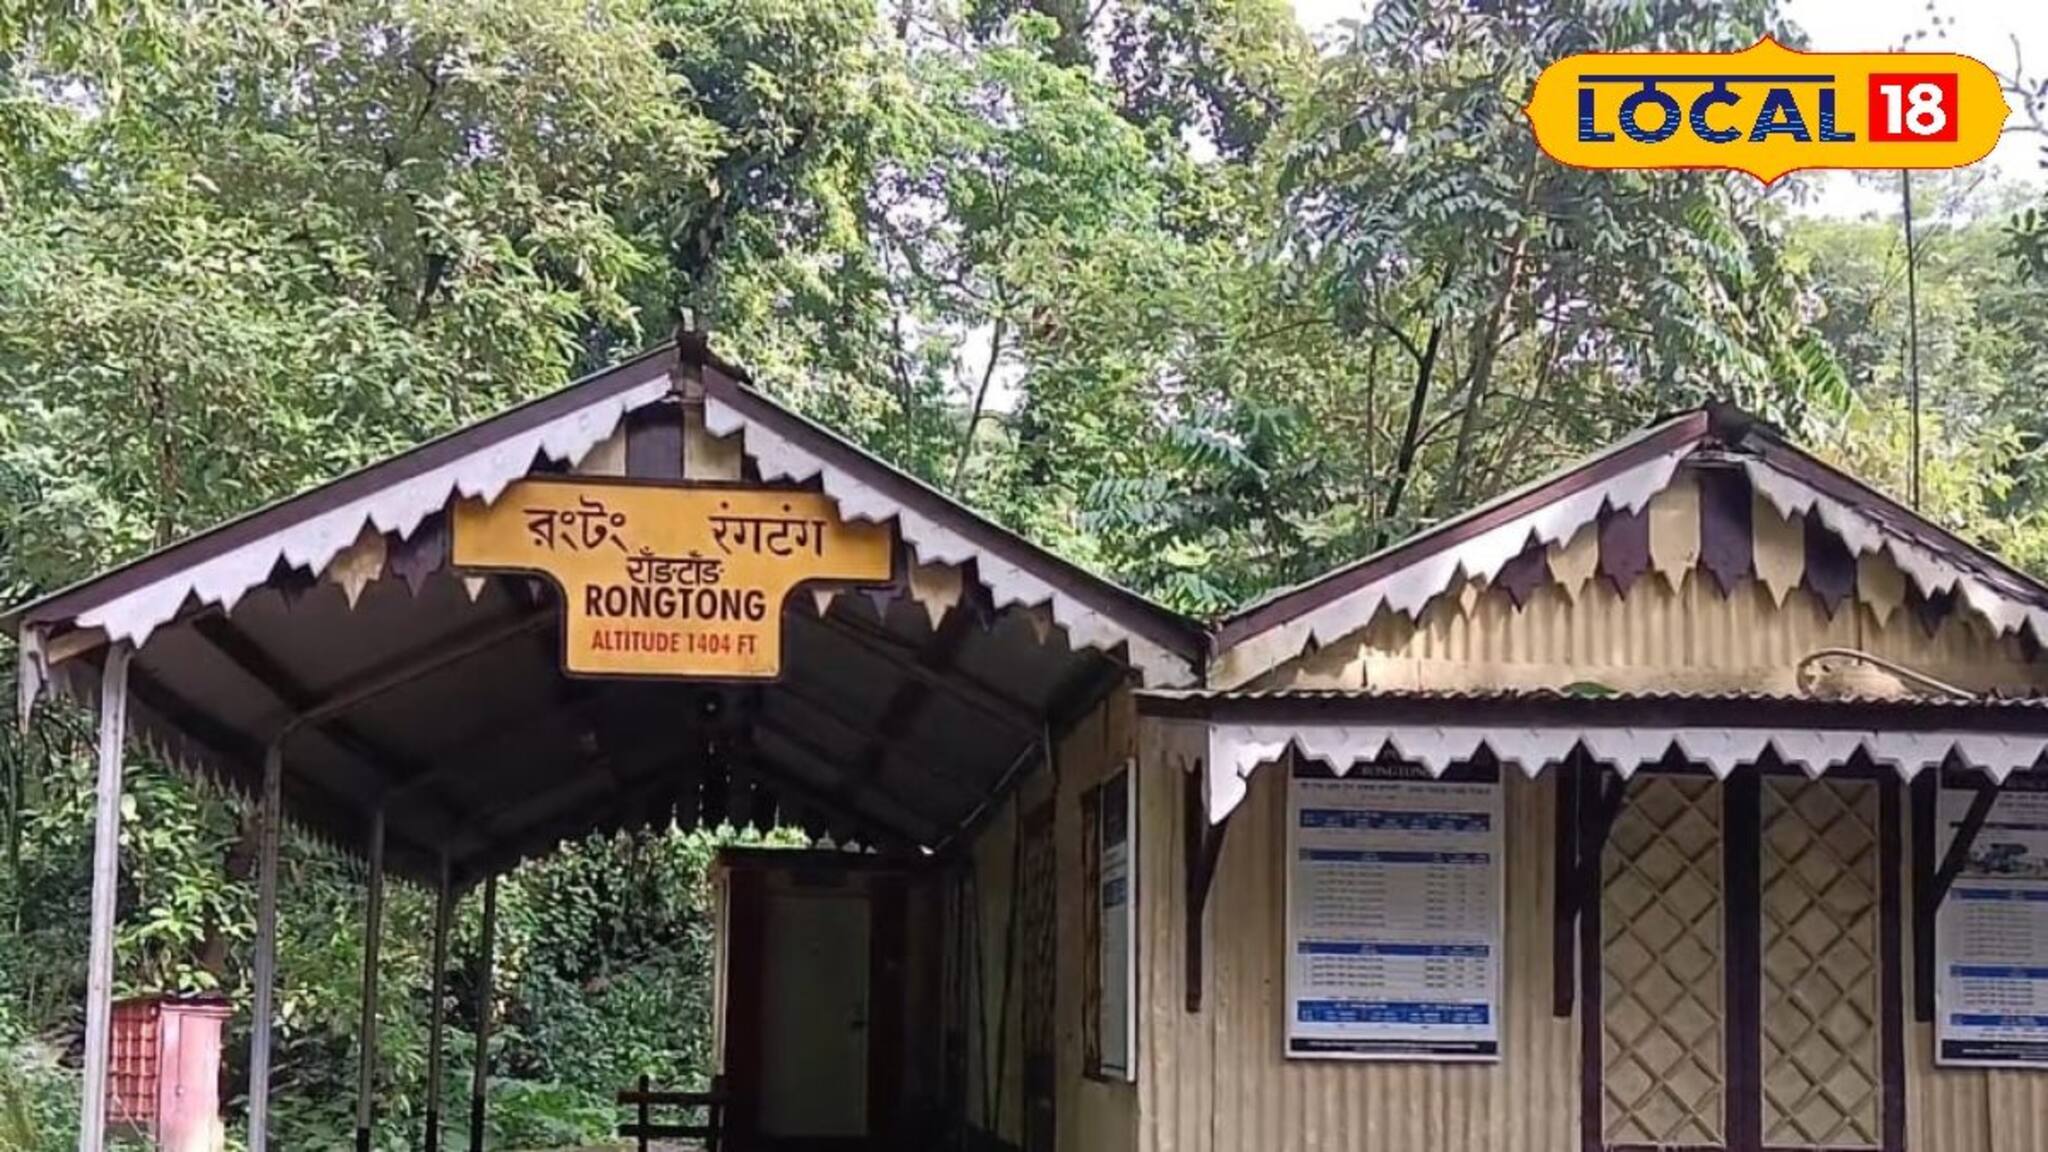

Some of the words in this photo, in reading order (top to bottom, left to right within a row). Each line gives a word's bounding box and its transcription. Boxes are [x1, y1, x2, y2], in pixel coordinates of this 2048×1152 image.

[522, 495, 629, 552] রংটং
[708, 501, 827, 557] रंगटंग
[585, 586, 767, 621] RONGTONG
[591, 629, 681, 653] ALTITUDE
[688, 631, 732, 654] 1404
[737, 633, 759, 655] FT
